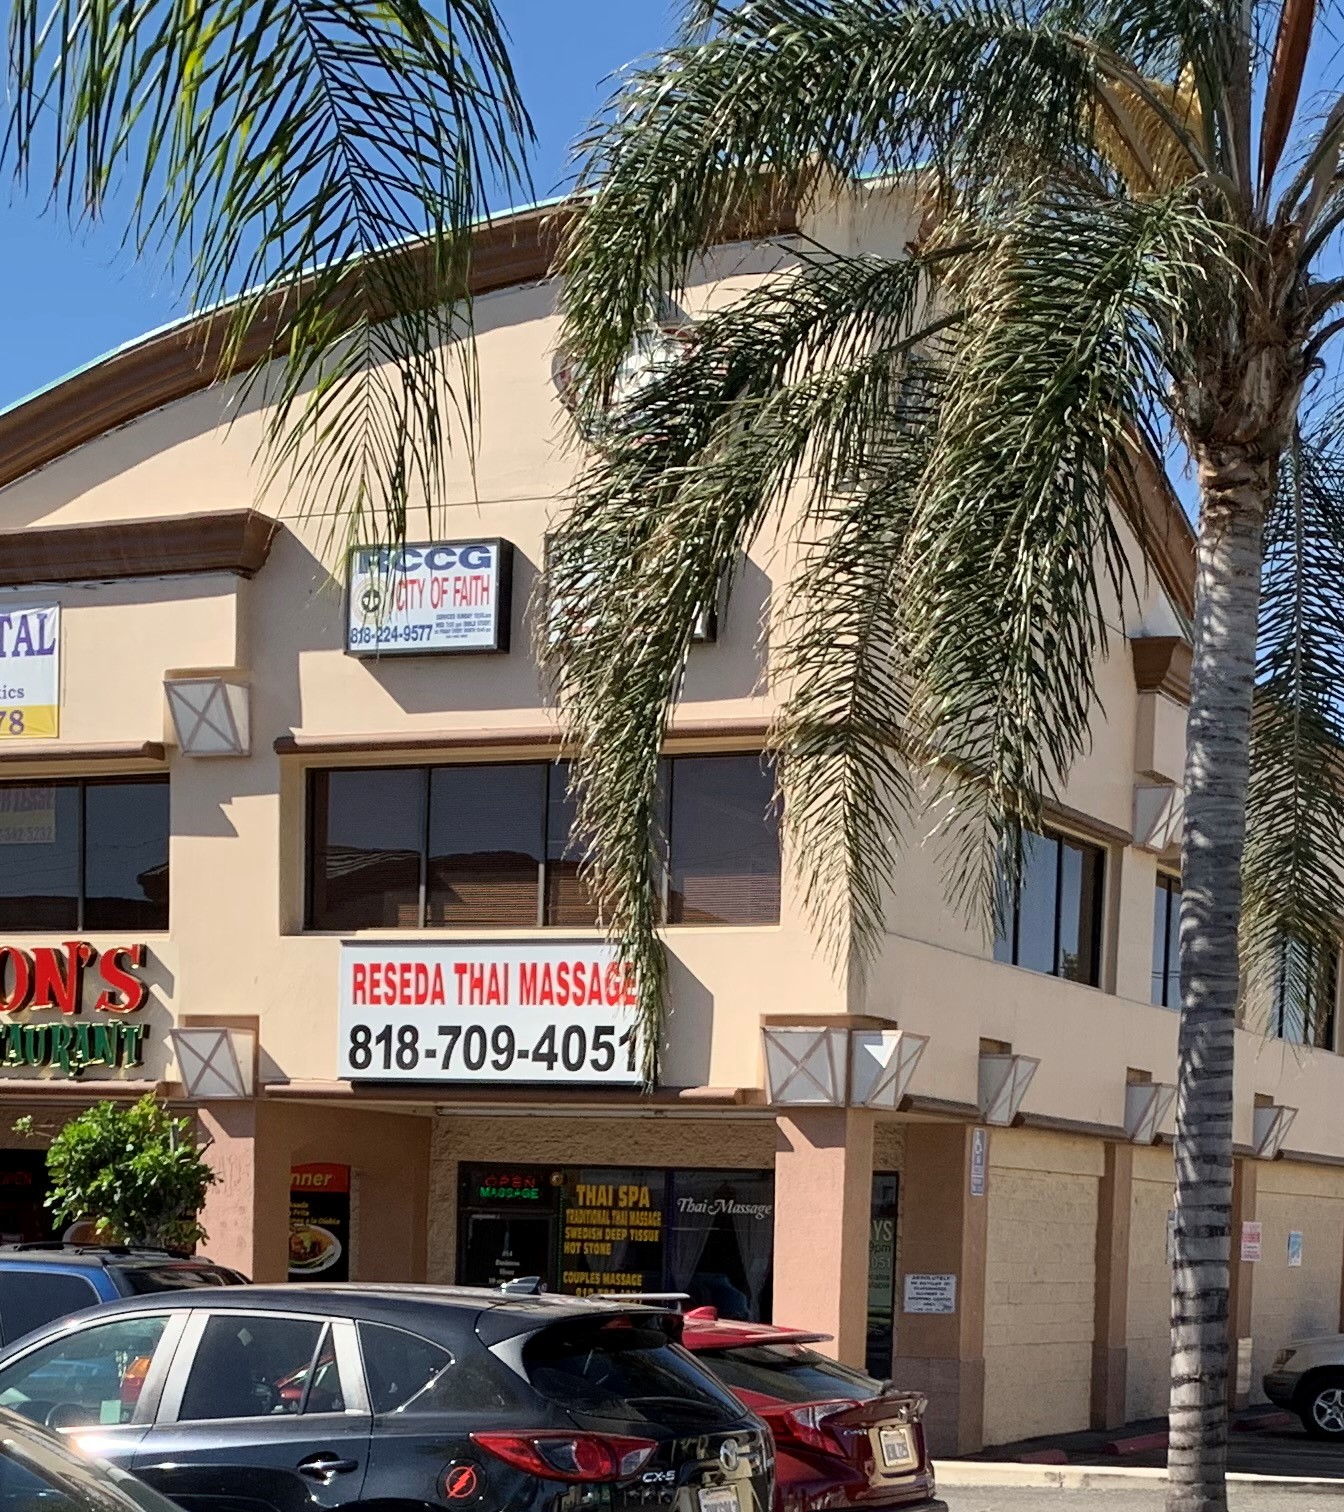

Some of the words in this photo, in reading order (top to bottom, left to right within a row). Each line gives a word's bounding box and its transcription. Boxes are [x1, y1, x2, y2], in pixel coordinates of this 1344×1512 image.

[396, 577, 426, 611] CITY
[430, 576, 449, 608] OF
[453, 574, 490, 607] FAITH
[350, 624, 433, 644] 818-224-9577
[352, 962, 446, 1006] RESEDA
[454, 962, 508, 1006] THAI
[519, 961, 637, 1006] MASSAGE
[349, 1023, 637, 1073] 818-709-4051
[485, 1176, 536, 1188] OPEN
[480, 1186, 539, 1199] MASSAGE
[576, 1184, 613, 1207] THAI
[618, 1185, 650, 1208] SPA
[676, 1197, 706, 1214] Thai
[708, 1198, 773, 1219] Massage
[629, 1210, 662, 1227] MASSAGE
[565, 1226, 603, 1241] SWEDISH
[605, 1227, 628, 1241] DEEP
[629, 1229, 661, 1242] TISSUE
[564, 1241, 582, 1254] HOT
[583, 1242, 612, 1255] STONE
[563, 1271, 601, 1284] COUPLES
[602, 1272, 643, 1286] MASSAGE
[642, 1470, 676, 1483] CX-5
